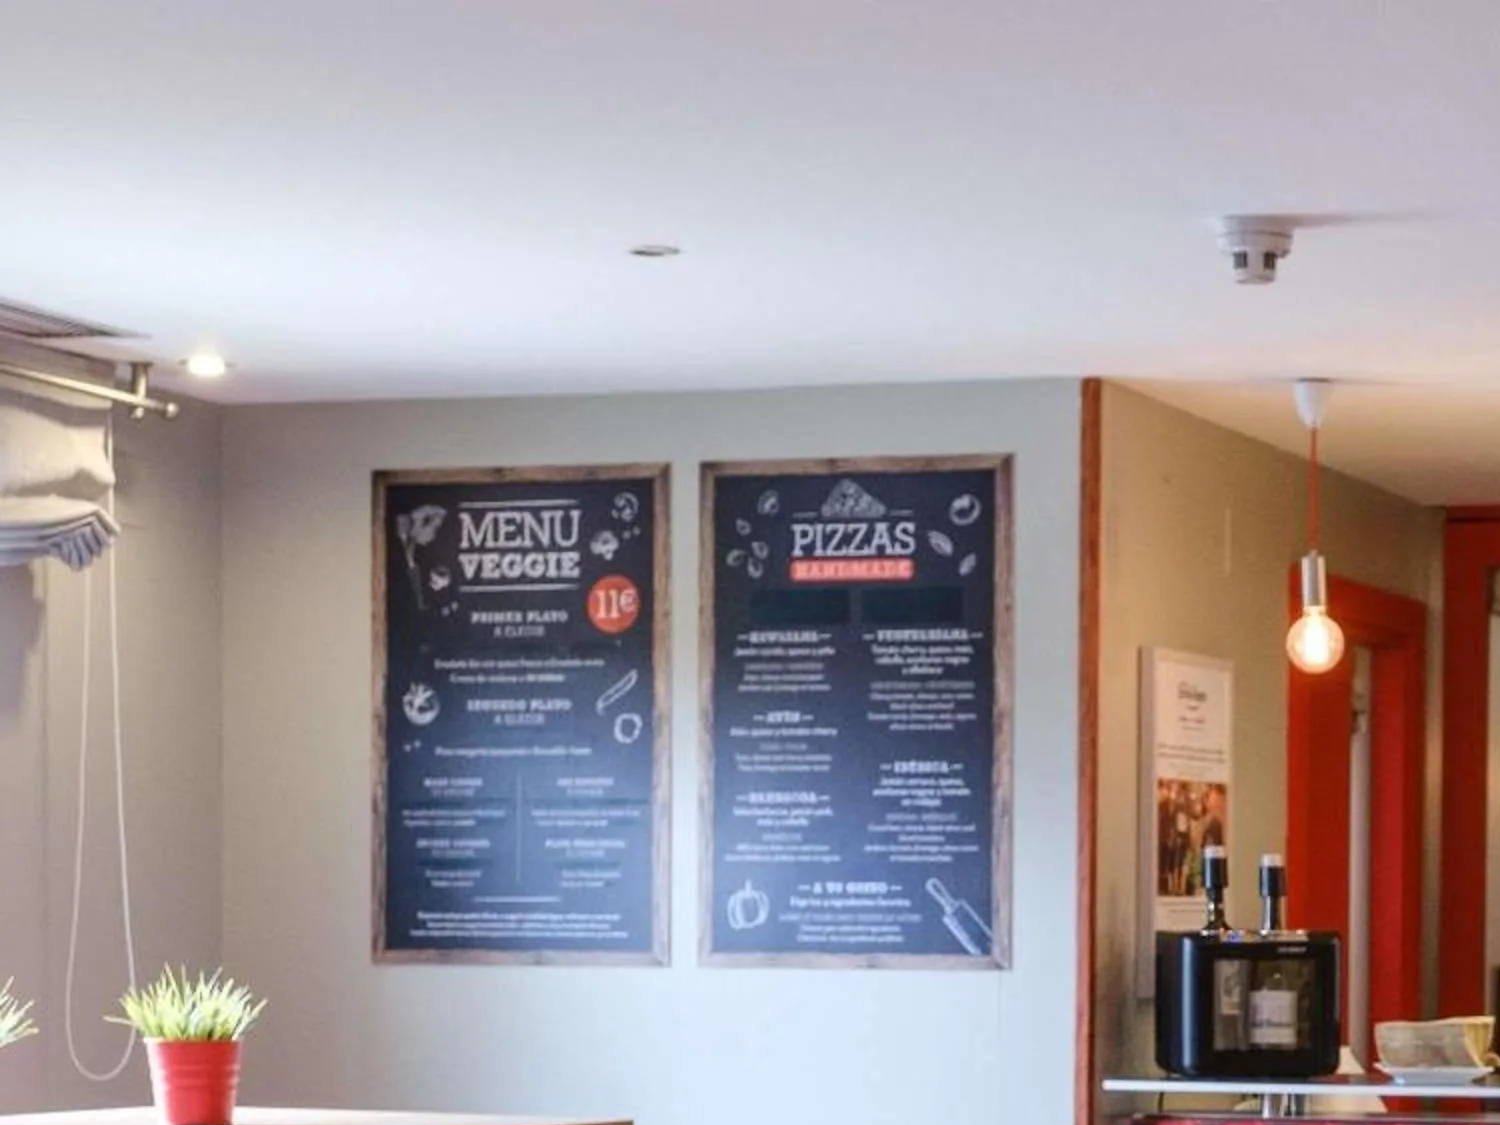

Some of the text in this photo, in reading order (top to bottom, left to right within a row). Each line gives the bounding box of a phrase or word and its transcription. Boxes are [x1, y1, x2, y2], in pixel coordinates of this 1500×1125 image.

[459, 510, 582, 549] MENU
[791, 522, 916, 557] PIZZAS
[458, 551, 581, 580] VEGGIE
[795, 559, 913, 580] HANDMADE
[471, 610, 568, 624] PRIMER PLATO
[597, 588, 638, 618] 11€
[530, 698, 572, 711] PLATO
